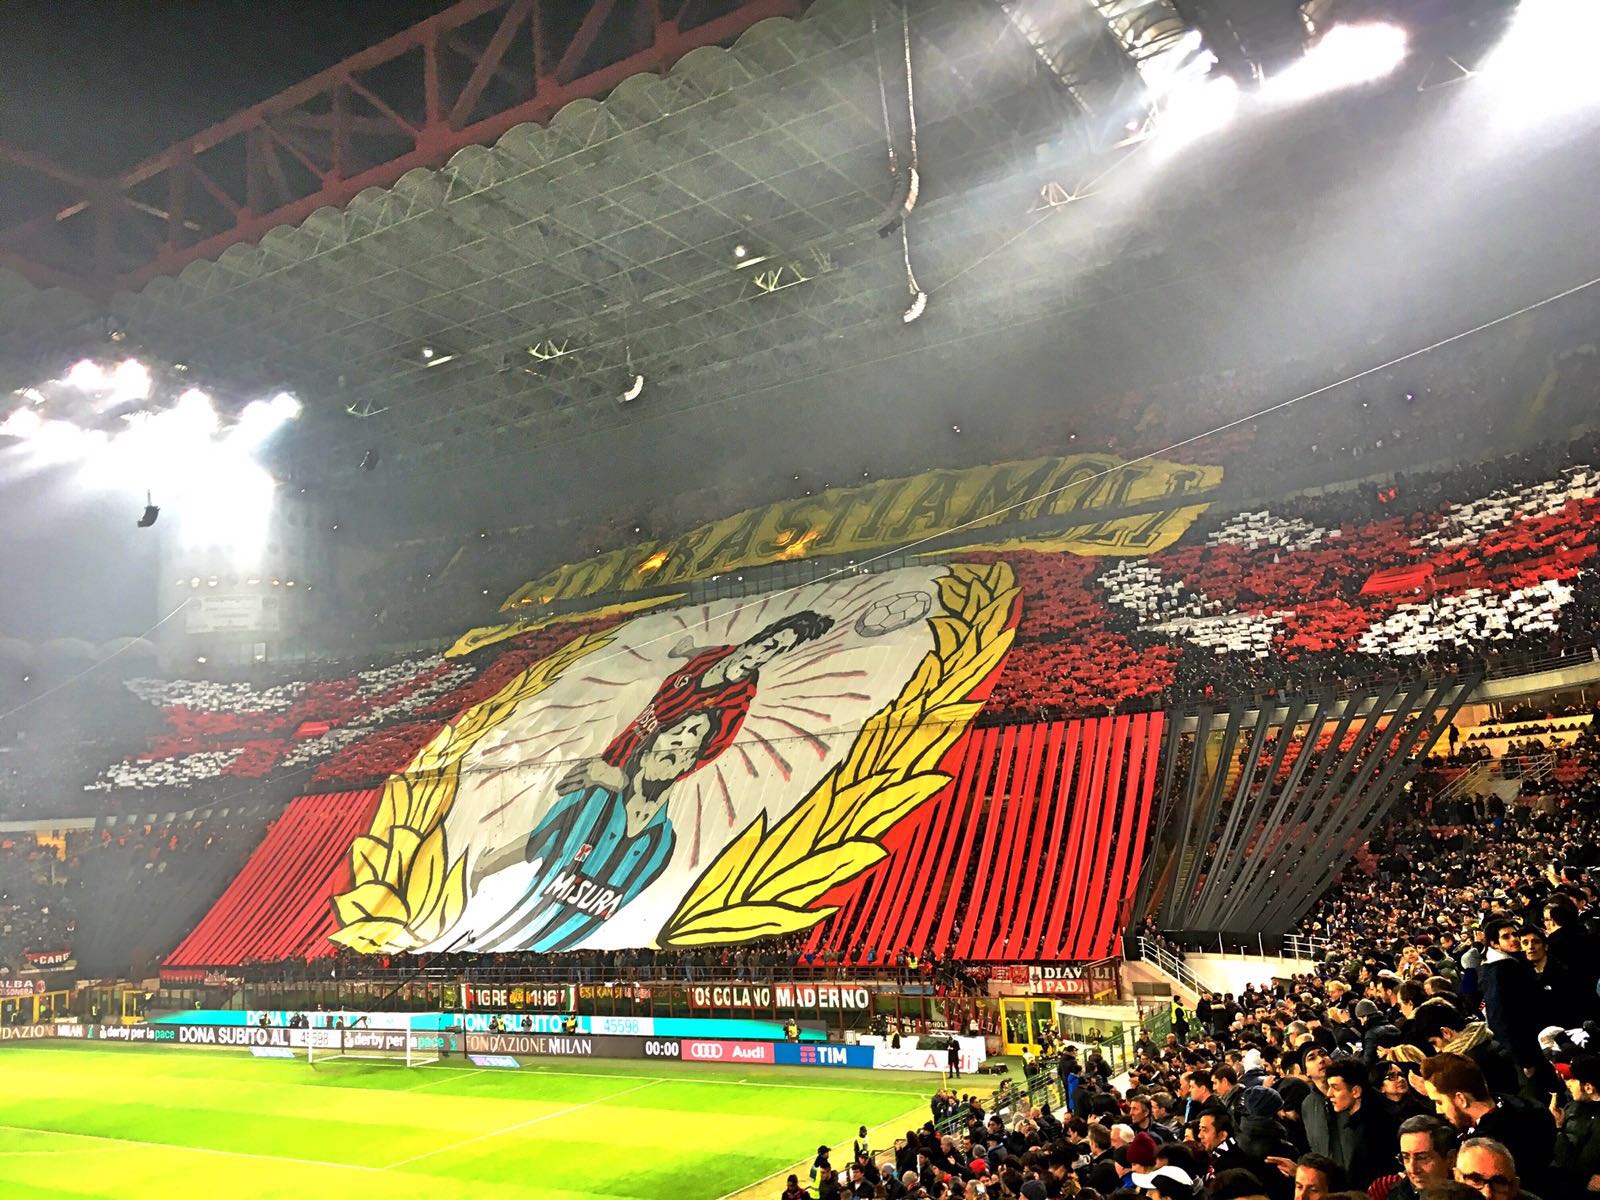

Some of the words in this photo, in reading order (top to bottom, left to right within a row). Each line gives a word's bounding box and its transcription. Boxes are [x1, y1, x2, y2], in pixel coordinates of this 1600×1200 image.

[775, 988, 869, 1008] MADERNO
[180, 1027, 215, 1043] DONA
[218, 1029, 268, 1046] SUBITO
[269, 1031, 289, 1046] AL
[466, 1036, 546, 1054] FONDAZIONE
[548, 1037, 592, 1054] MILAN
[645, 1041, 679, 1057] 00:00
[732, 1046, 765, 1059] Audi
[816, 1047, 848, 1064] TIM
